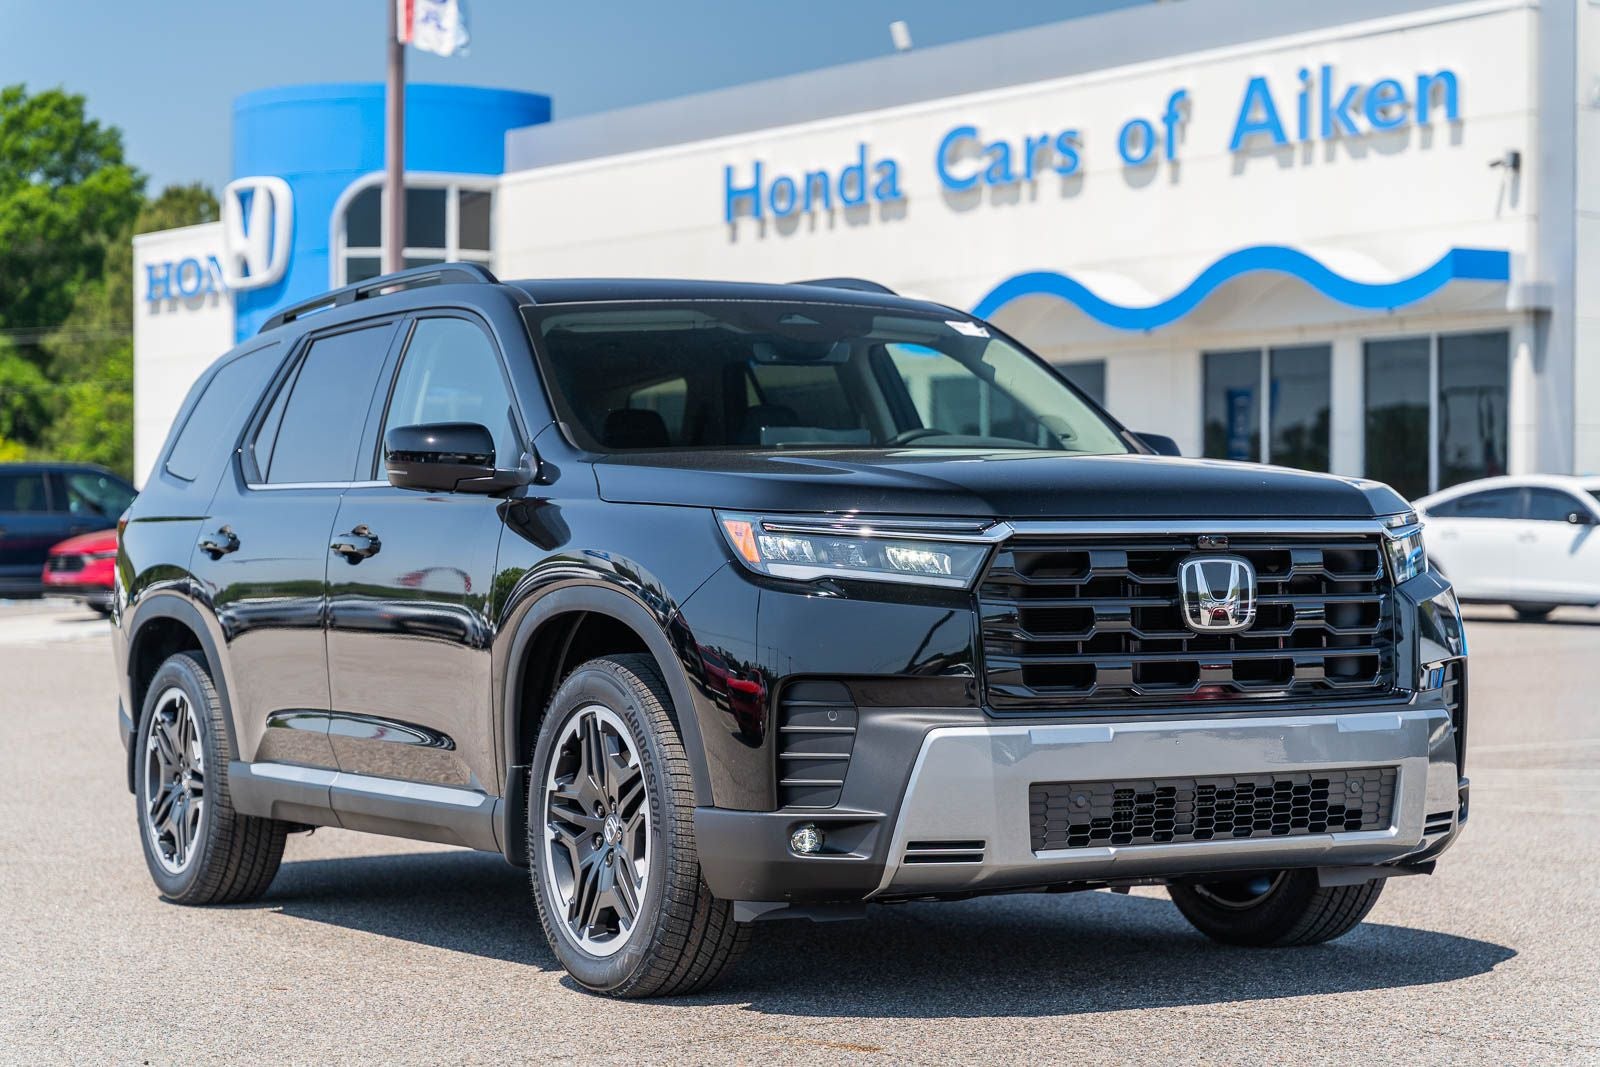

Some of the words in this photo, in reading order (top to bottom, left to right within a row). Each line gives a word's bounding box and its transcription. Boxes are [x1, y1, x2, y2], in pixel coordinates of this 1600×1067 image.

[723, 143, 903, 224] Honda
[935, 124, 1081, 191] Cars
[1117, 88, 1188, 166] of
[1228, 63, 1459, 151] Aiken
[624, 705, 662, 838] BRIDGESTONE
